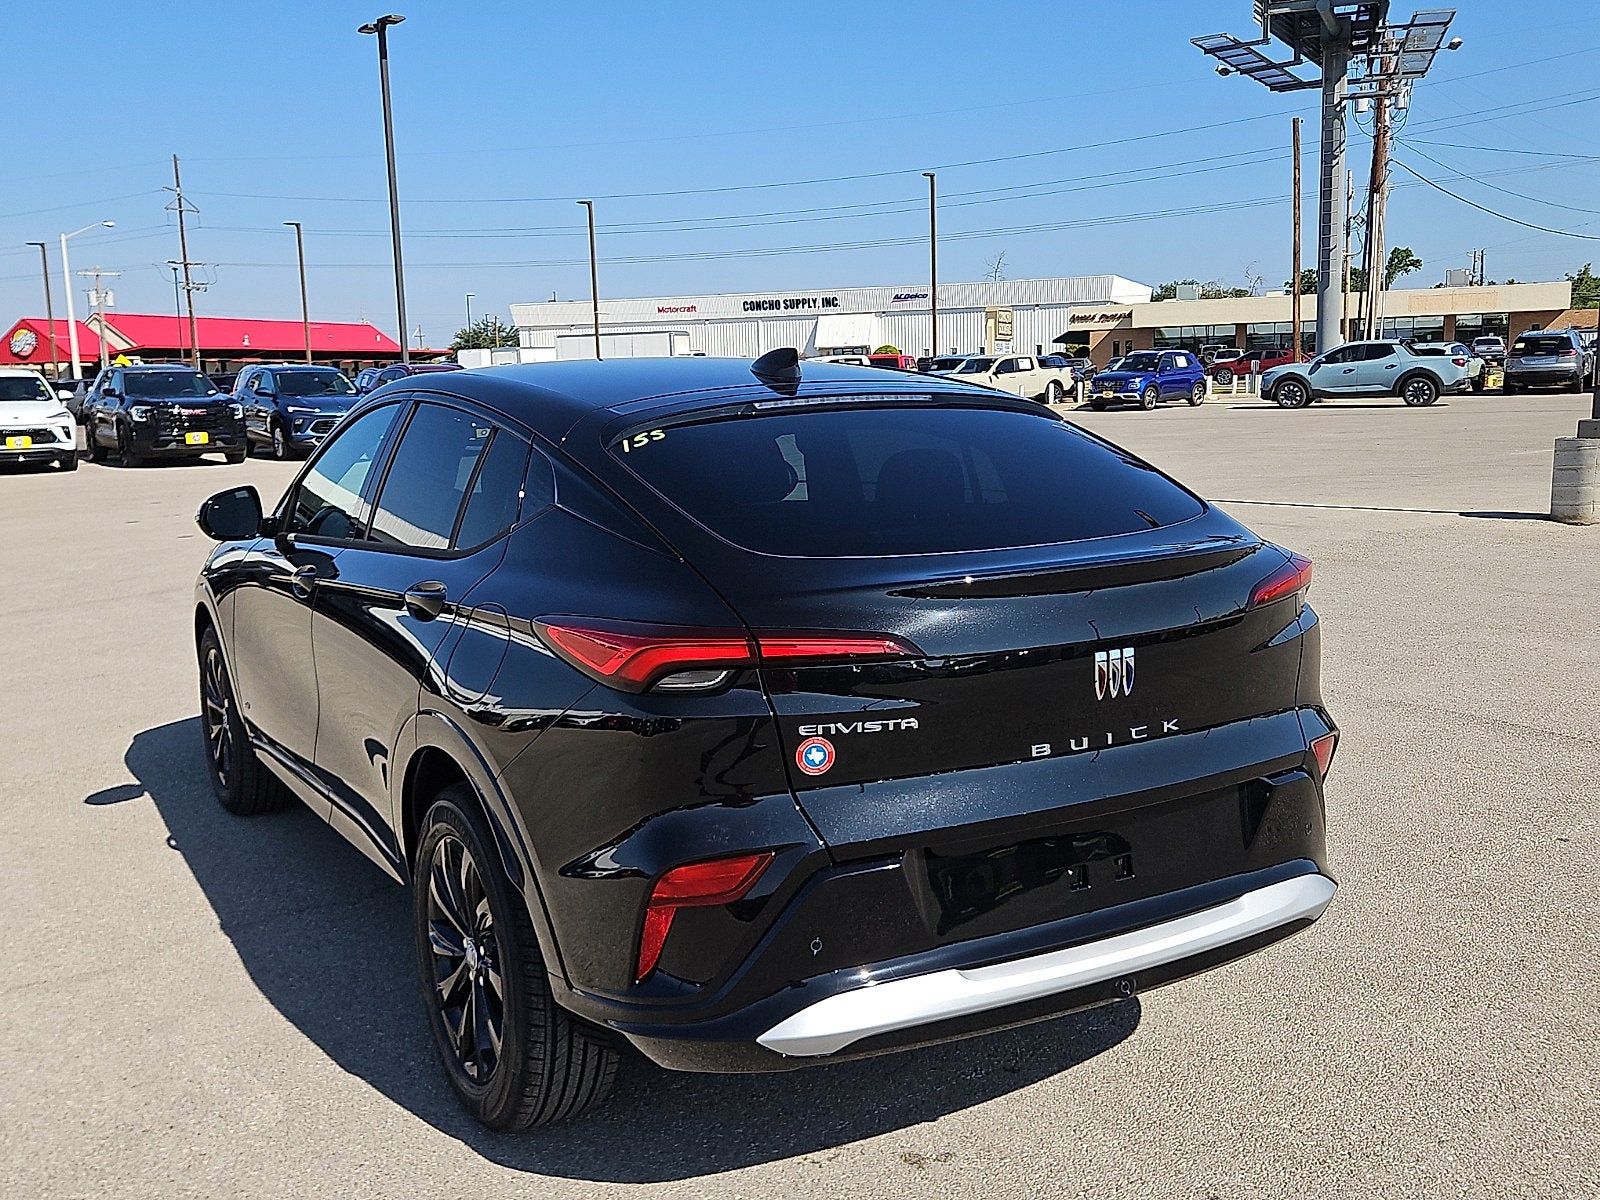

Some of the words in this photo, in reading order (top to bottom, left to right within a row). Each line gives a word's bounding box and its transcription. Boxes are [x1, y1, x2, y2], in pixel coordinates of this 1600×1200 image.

[742, 299, 781, 312] CONCHO
[782, 297, 820, 311] SUPPLY,
[821, 296, 841, 309] INC.
[892, 292, 929, 303] ACDelco
[657, 304, 697, 314] Motorcraft
[798, 717, 919, 736] ENVISTA
[1030, 717, 1180, 758] BUICK
